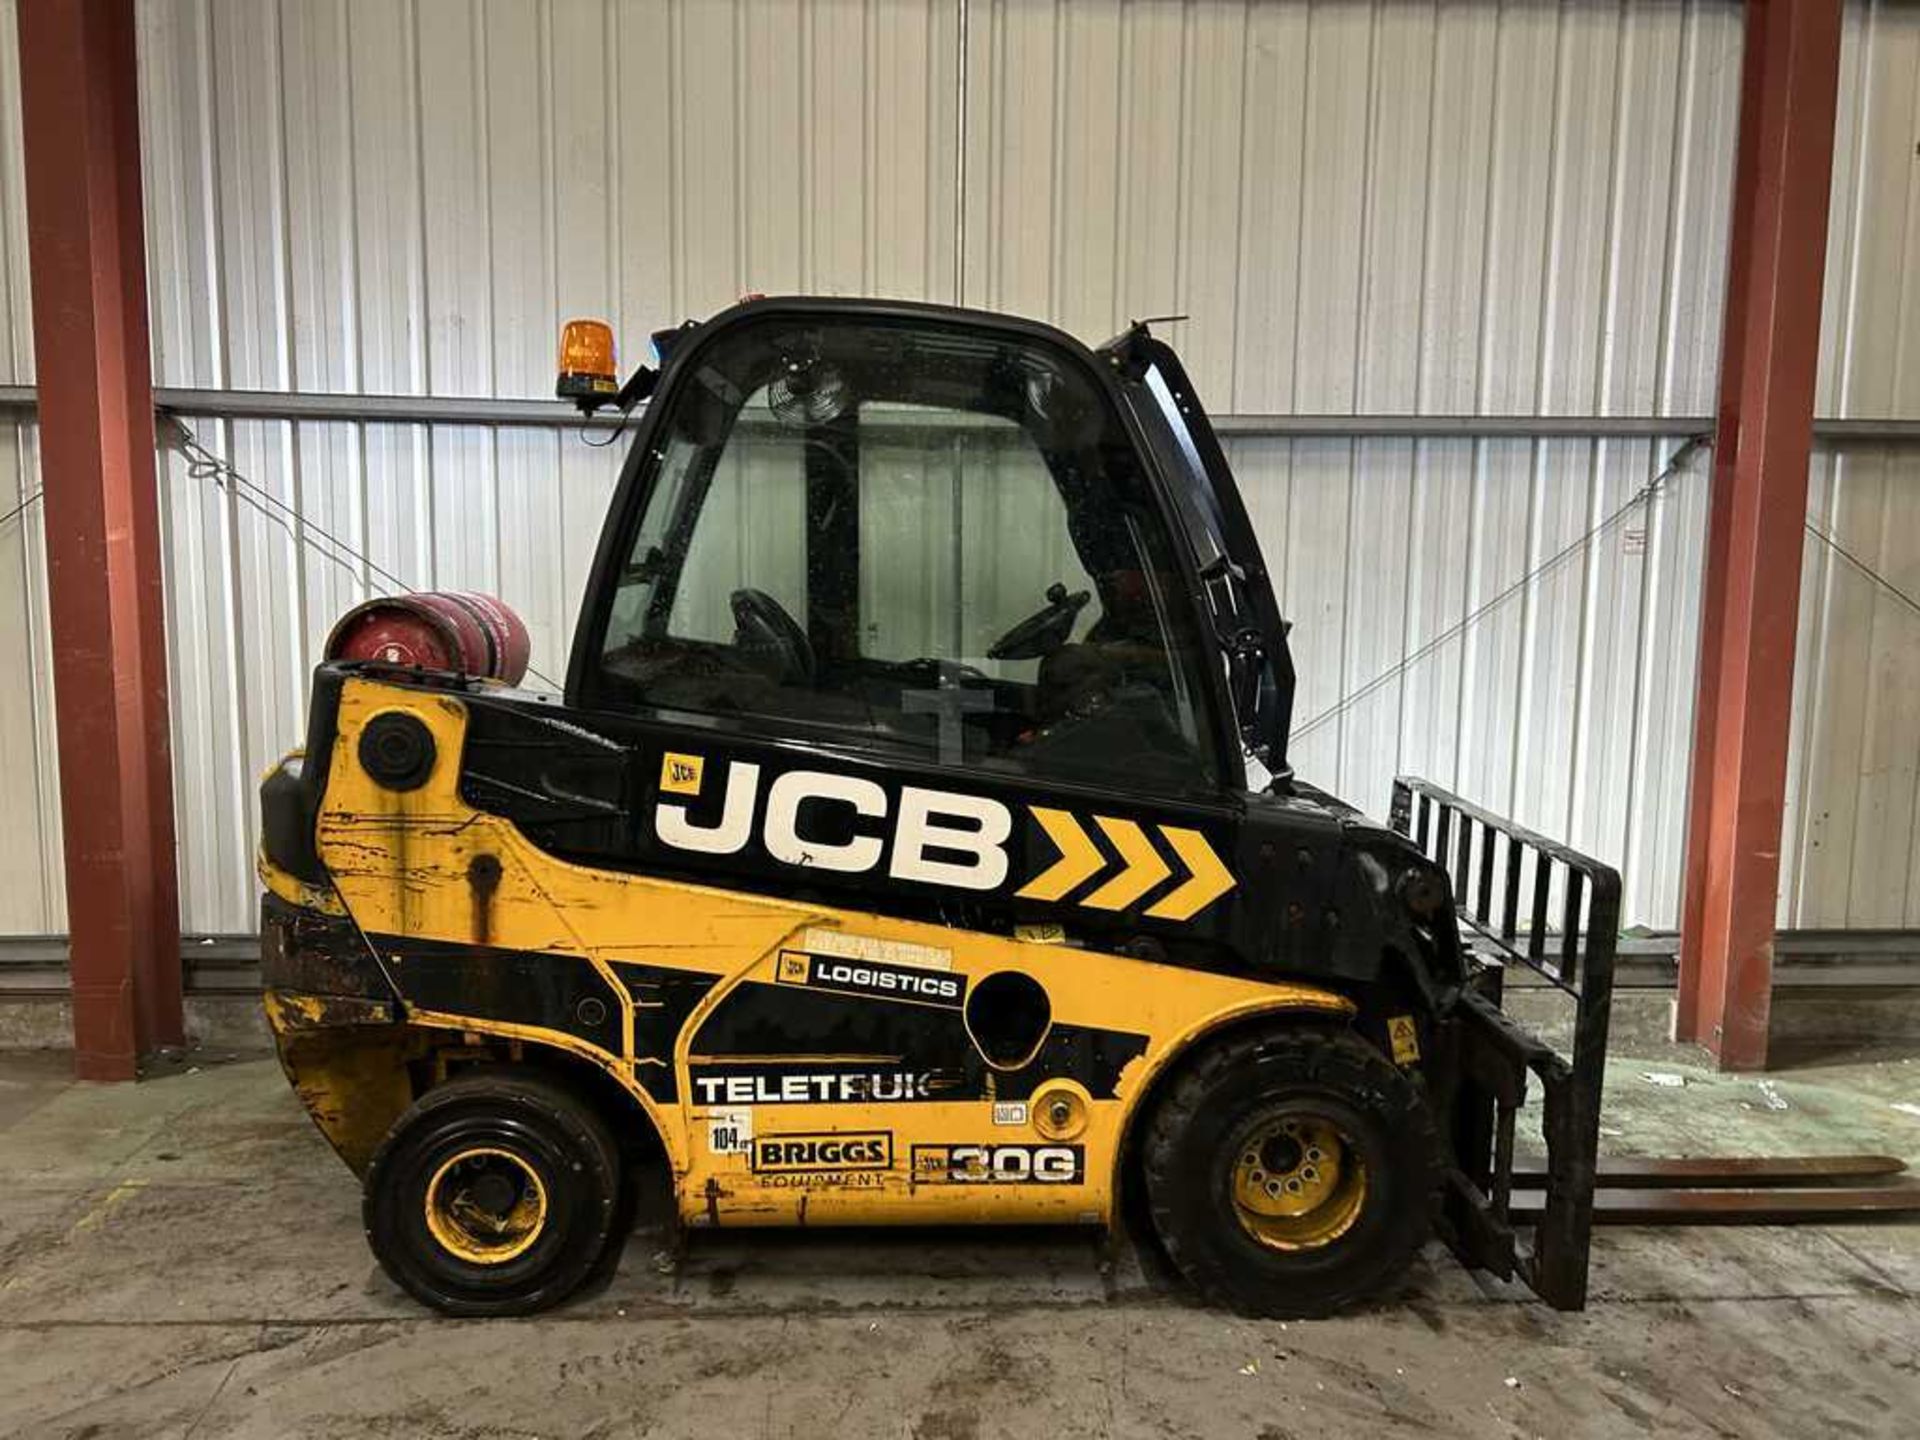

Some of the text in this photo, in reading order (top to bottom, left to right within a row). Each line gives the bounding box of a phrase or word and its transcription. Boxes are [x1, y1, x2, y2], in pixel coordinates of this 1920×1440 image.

[655, 761, 1012, 891] JCB
[816, 963, 958, 997] LOGISTICS
[713, 1127, 738, 1150] 104
[761, 1140, 884, 1165] BRIGGS
[952, 1147, 1075, 1181] 30G
[761, 1173, 884, 1188] EQUIPMENT
